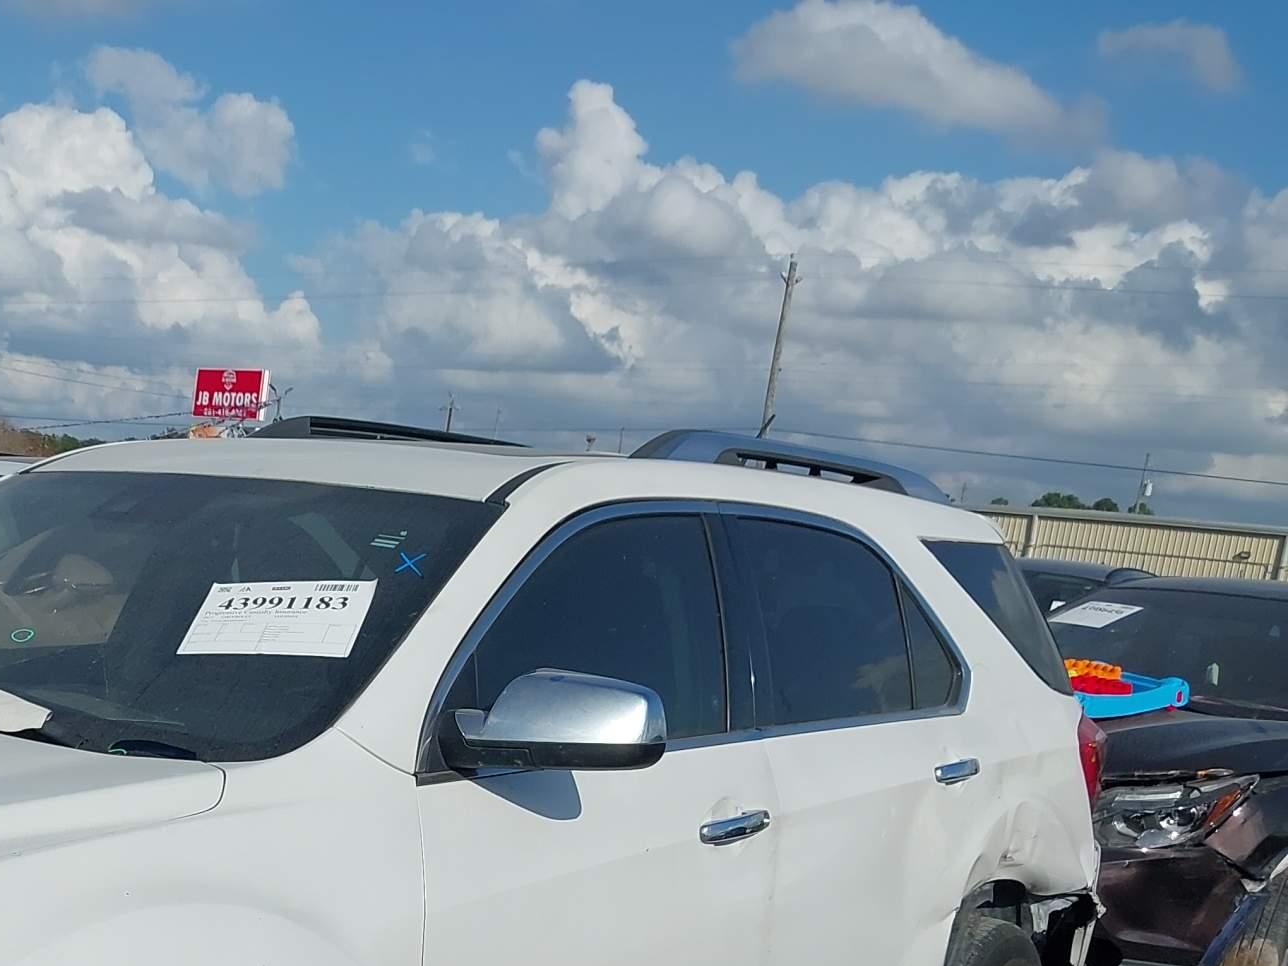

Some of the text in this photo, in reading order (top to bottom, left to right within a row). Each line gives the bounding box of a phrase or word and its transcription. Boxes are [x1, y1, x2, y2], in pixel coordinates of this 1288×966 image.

[196, 390, 258, 408] JB MOTORS
[217, 595, 350, 611] 43991183
